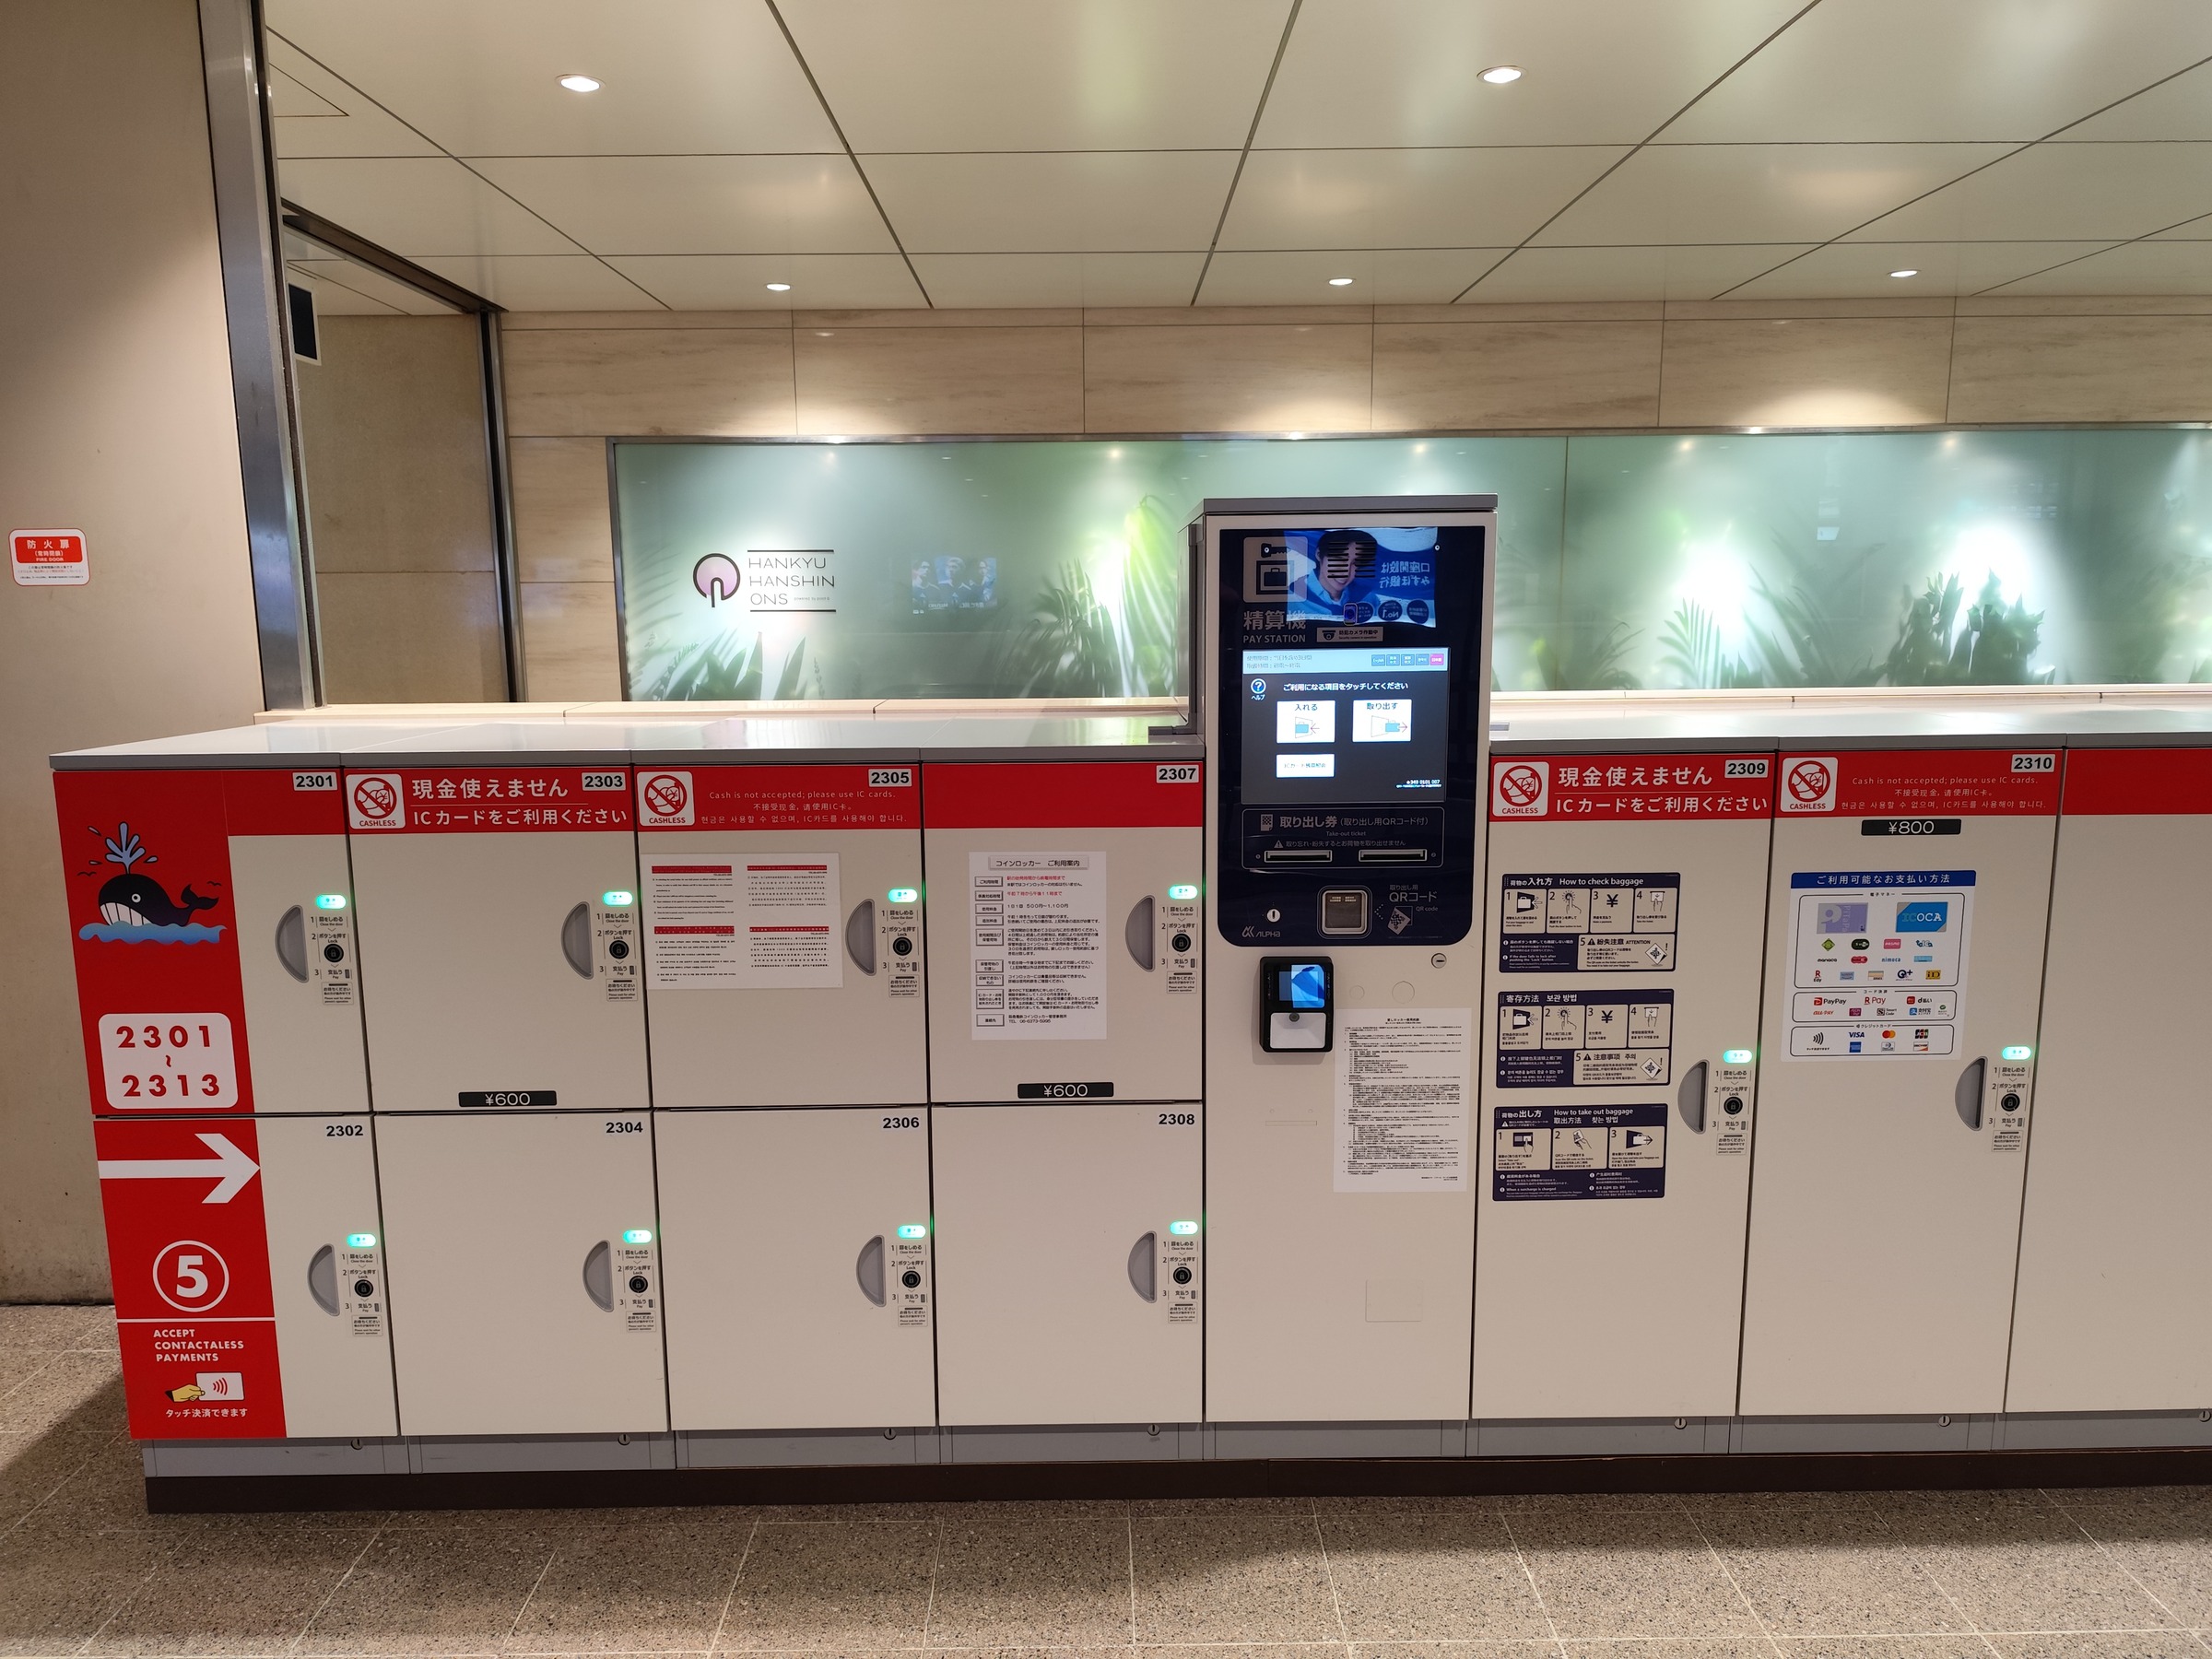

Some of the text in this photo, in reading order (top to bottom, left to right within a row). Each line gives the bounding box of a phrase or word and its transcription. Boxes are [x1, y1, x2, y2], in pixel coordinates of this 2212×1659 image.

[748, 557, 826, 569] HANKYU
[749, 575, 835, 587] HANSHIN
[750, 593, 789, 606] ONS
[1243, 610, 1306, 630] 精算機
[1244, 634, 1306, 643] PAY STATION
[1283, 682, 1408, 691] ご利用になる項目をタッチしてください
[1294, 703, 1318, 712] 入れる
[1366, 702, 1399, 711] 取り出す
[1727, 762, 1766, 775] 2309
[2014, 758, 2053, 770] 2310
[871, 771, 909, 783] 2305
[1159, 769, 1196, 780] 2307
[1559, 767, 1712, 787] 現金使えません
[296, 775, 333, 787] 2301
[584, 775, 623, 787] 2303
[1853, 777, 1874, 785] Cash
[1904, 776, 1948, 785] accepted;
[1950, 776, 1978, 785] please
[413, 779, 568, 799] 現金使えません
[710, 791, 732, 799] Cash
[761, 791, 806, 800] accepted;
[807, 791, 833, 800] please
[1279, 816, 1336, 828] 取り出し券
[1888, 821, 1935, 835] ¥800
[1510, 877, 1553, 886] 荷物の入れ方
[1611, 877, 1644, 887] baggage
[1818, 875, 1950, 885] ご利用可能なお支払い方法
[1389, 891, 1438, 903] QRコード
[1637, 891, 1642, 900] 4
[1902, 912, 1943, 922] ICOCA
[1506, 994, 1539, 1003] 寄存方法
[1502, 1009, 1506, 1018] 1
[1545, 1008, 1550, 1018] 2
[1630, 1007, 1637, 1016] 4
[116, 1025, 210, 1049] 2301
[1576, 1053, 1582, 1062] 5
[122, 1074, 219, 1097] 2313
[1043, 1084, 1088, 1097] ¥600
[485, 1093, 531, 1106] ¥600
[1158, 1113, 1195, 1125] 2308
[1502, 1110, 1543, 1119] 荷物の出し方
[606, 1122, 643, 1134] 2304
[882, 1117, 920, 1129] 2306
[326, 1124, 363, 1137] 2302
[1554, 1131, 1560, 1139] 2
[153, 1329, 195, 1338] ACCEPT
[155, 1340, 244, 1350] CONTACTALESS
[156, 1353, 219, 1362] PAYMENTS
[166, 1408, 248, 1418] タッチ決済できます
